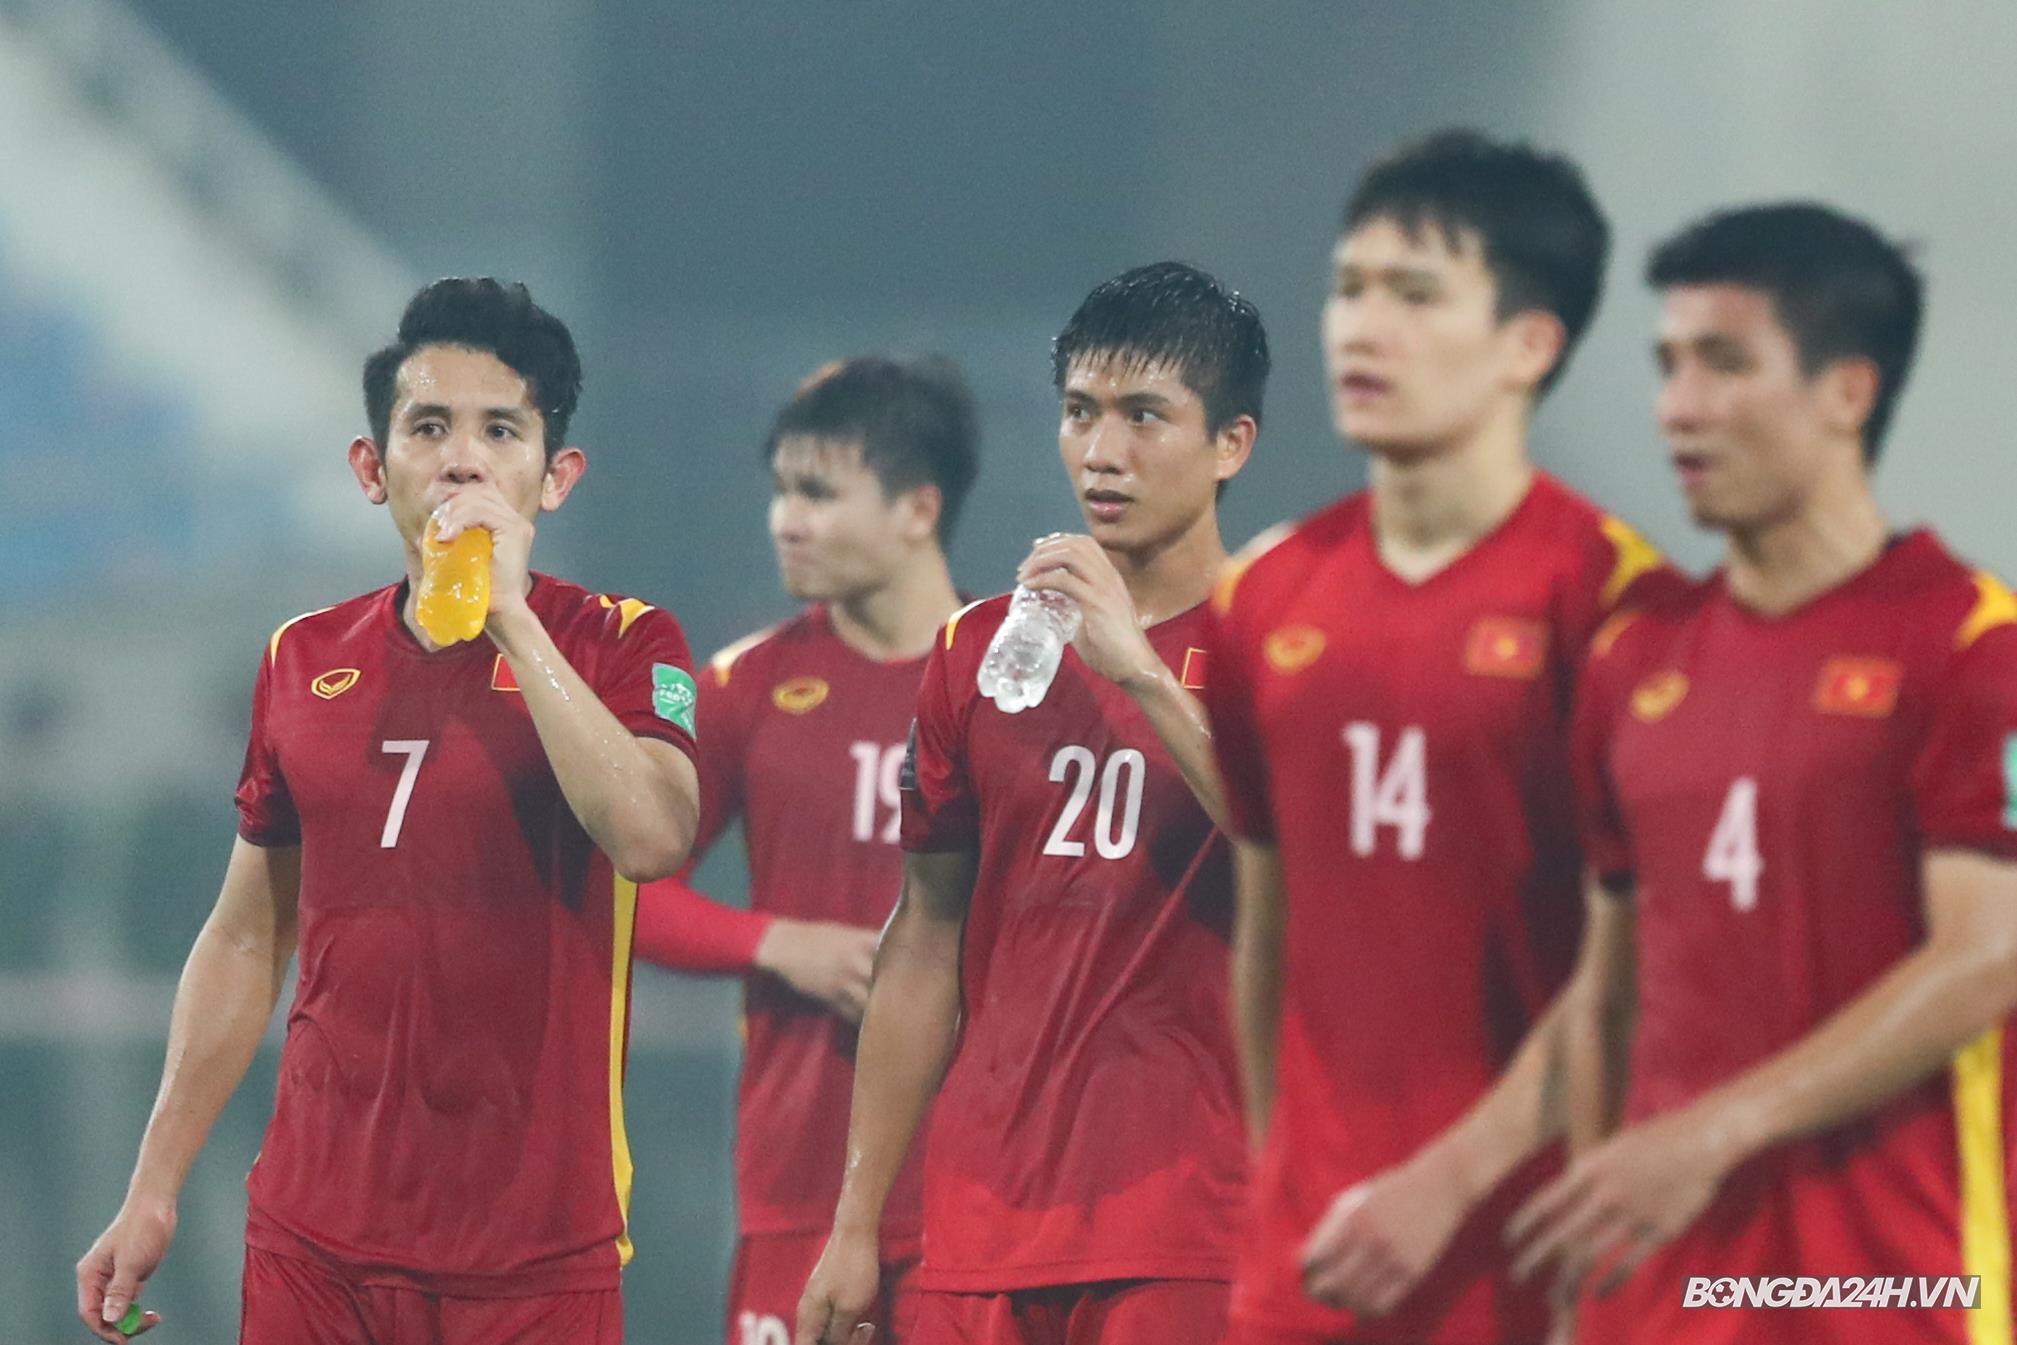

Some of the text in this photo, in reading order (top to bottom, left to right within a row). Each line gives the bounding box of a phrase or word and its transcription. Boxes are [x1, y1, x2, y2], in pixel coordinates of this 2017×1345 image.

[380, 739, 430, 849] 7
[849, 740, 907, 844] 19
[1042, 744, 1146, 860] 20
[1344, 723, 1430, 858] 14
[1704, 778, 1762, 909] 4
